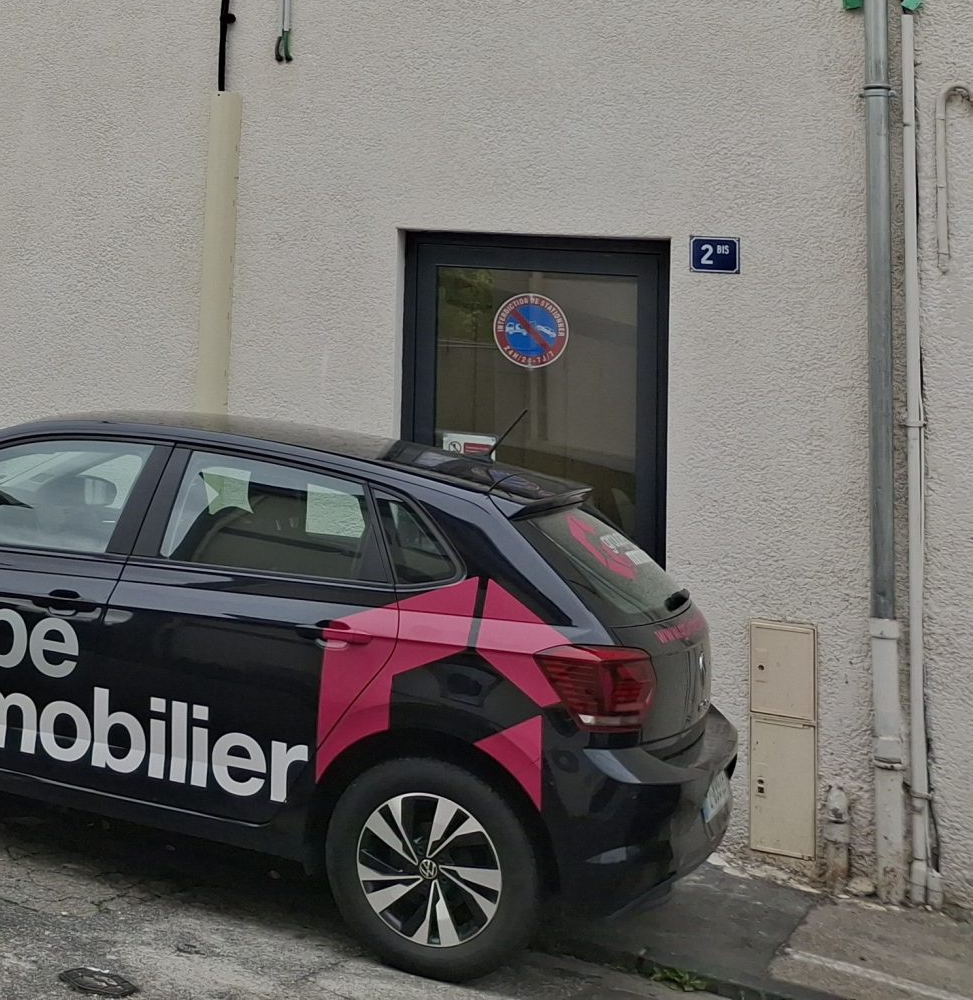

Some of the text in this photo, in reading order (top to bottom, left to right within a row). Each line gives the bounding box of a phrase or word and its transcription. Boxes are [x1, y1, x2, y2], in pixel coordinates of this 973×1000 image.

[700, 244, 730, 265] 2 BIS
[497, 297, 565, 337] INTERDICTION DE STATIONNER
